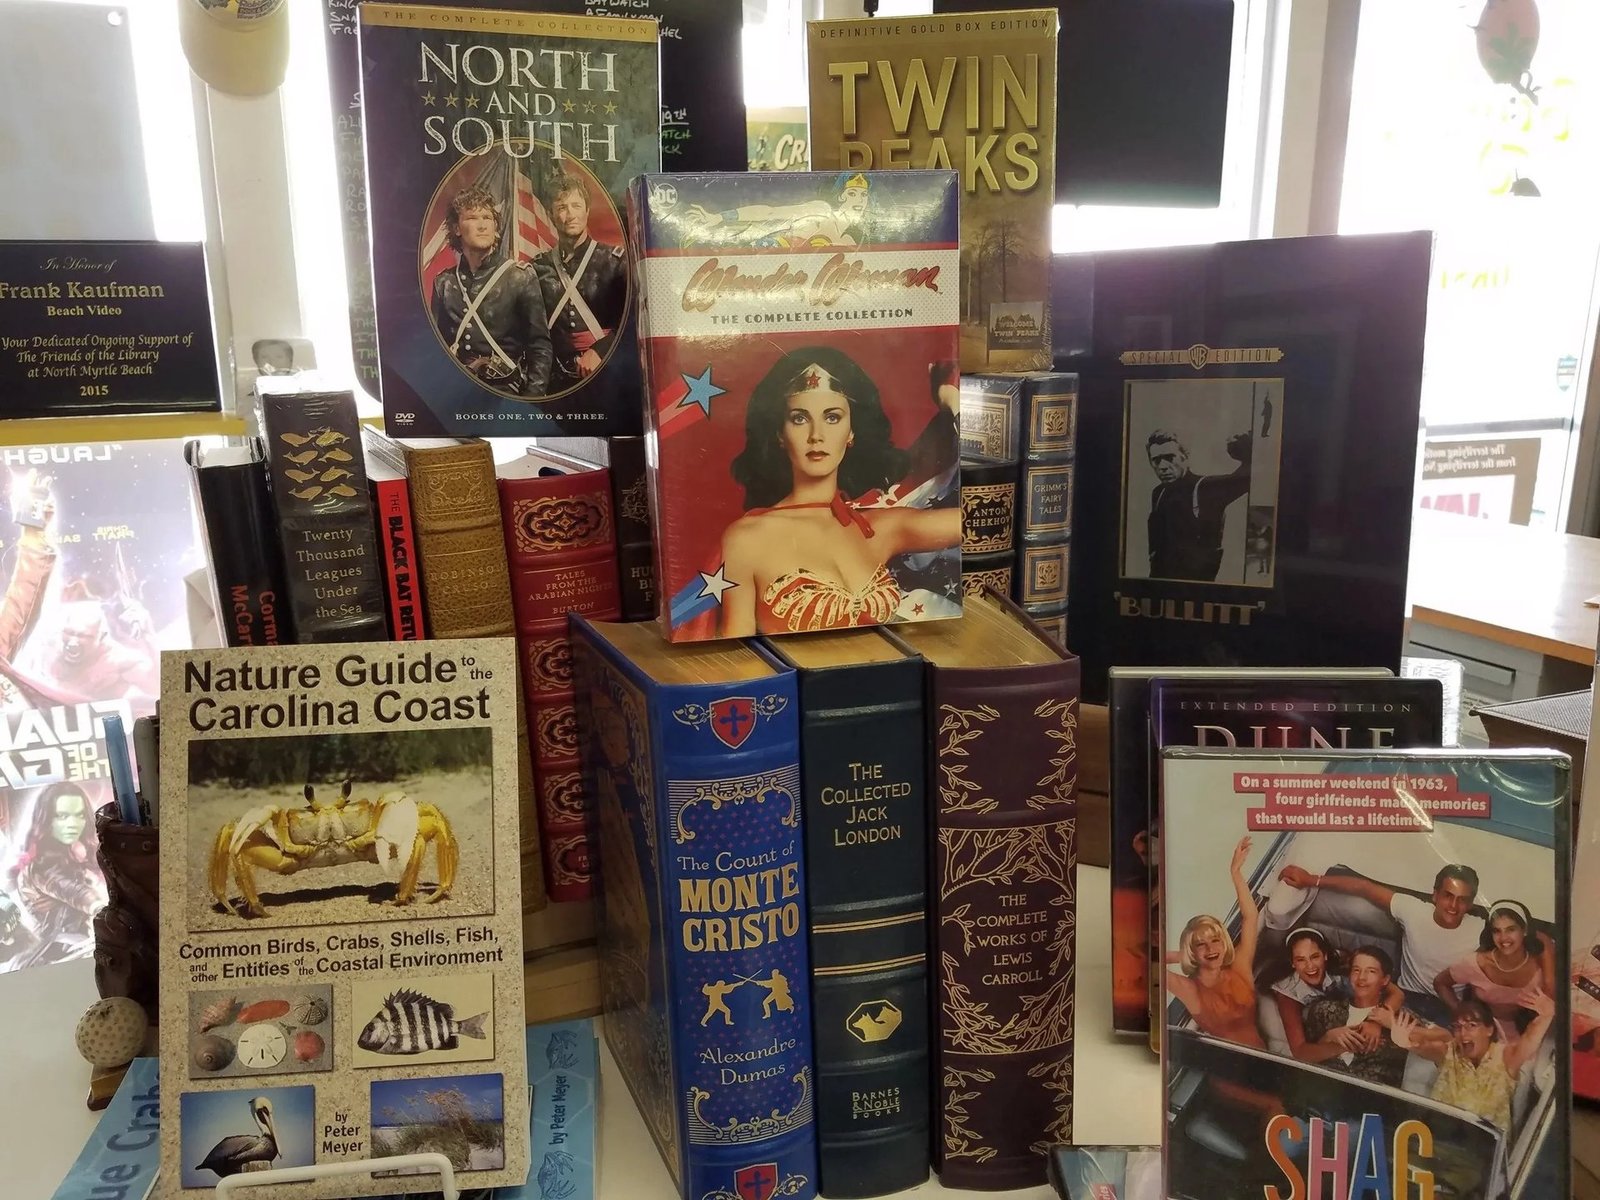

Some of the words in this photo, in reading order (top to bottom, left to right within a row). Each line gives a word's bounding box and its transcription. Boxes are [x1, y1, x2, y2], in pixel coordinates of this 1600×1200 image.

[383, 10, 417, 22] THE
[430, 13, 526, 27] COMPLETE
[538, 20, 648, 35] COLLECTION
[820, 25, 902, 39] DEFINITIVE
[911, 23, 945, 34] GOLD
[955, 21, 981, 32] BOX
[991, 18, 1049, 30] EDITION
[418, 41, 619, 93] NORTH
[828, 53, 1039, 135] TWIN
[485, 92, 556, 116] AND
[424, 116, 621, 163] SOUTH
[774, 134, 807, 170] CR
[839, 132, 1039, 192] PEAKS
[40, 258, 58, 270] In
[63, 257, 101, 271] Honor
[104, 259, 117, 273] of
[0, 282, 61, 299] Frank
[67, 281, 164, 298] Kaufman
[681, 257, 809, 312] Wonder
[808, 252, 941, 307] Woman
[47, 305, 84, 316] Beach
[88, 305, 122, 316] Video
[711, 314, 739, 325] THE
[744, 312, 821, 324] COMPLETE
[826, 308, 914, 321] COLLECTION
[1, 336, 29, 350] Your
[32, 334, 88, 347] Dedicated
[91, 335, 135, 350] Ongoing
[138, 333, 179, 348] Support
[182, 332, 194, 347] of
[17, 351, 36, 364] The
[40, 350, 82, 364] Friends
[85, 349, 96, 364] of
[99, 349, 115, 361] the
[118, 349, 160, 362] Library
[1131, 351, 1181, 364] SPECIAL
[1215, 349, 1271, 362] EDITION
[27, 367, 39, 378] at
[43, 365, 76, 377] North
[80, 364, 118, 380] Myrtle
[121, 363, 153, 376] Beach
[80, 385, 109, 396] 2015
[499, 413, 525, 421] ONE,
[390, 491, 400, 513] THE
[1041, 494, 1063, 504] FAIRY
[973, 506, 1007, 517] ANTON
[1039, 505, 1062, 515] TALES
[965, 516, 1010, 527] CHEKHOV
[302, 528, 354, 543] Twenty
[388, 515, 410, 569] BLACK
[296, 545, 365, 562] Thousand
[305, 566, 363, 583] Leagues
[430, 565, 501, 580] ROBINSO
[555, 570, 586, 581] TALES
[395, 573, 413, 602] BAT
[545, 581, 575, 590] FROM
[577, 577, 596, 586] THE
[314, 585, 359, 600] Under
[528, 589, 575, 601] ARABIAN
[231, 585, 254, 646] McCar
[316, 607, 337, 619] the
[341, 604, 362, 619] Sea
[553, 602, 594, 614] BURTON
[184, 658, 321, 693] Nature
[335, 651, 458, 687] Guide
[461, 656, 476, 667] to
[470, 668, 493, 680] the
[188, 694, 359, 732] Carolina
[373, 686, 491, 723] Coast
[1180, 702, 1295, 712] EXTENDED
[1313, 703, 1412, 713] EDITION
[849, 762, 883, 781] THE
[1240, 776, 1260, 788] On
[1262, 779, 1270, 788] a
[1273, 779, 1329, 789] summer
[1330, 776, 1390, 789] weekend
[1393, 776, 1406, 789] in
[1410, 778, 1448, 791] 1963,
[820, 782, 911, 805] COLLECTED
[1275, 793, 1303, 805] four
[1306, 792, 1376, 809] girlfriends
[1420, 797, 1486, 810] memories
[846, 806, 888, 824] JACK
[1255, 812, 1283, 825] that
[1286, 812, 1327, 825] would
[1329, 812, 1354, 825] last
[1357, 815, 1365, 825] a
[834, 825, 901, 846] LONDON
[676, 856, 710, 871] The
[715, 847, 778, 872] Count
[782, 840, 795, 856] of
[678, 862, 800, 913] MONTE
[998, 894, 1027, 907] THE
[682, 902, 800, 953] CRISTO
[976, 911, 1047, 928] COMPLETE
[179, 942, 262, 960] Common
[267, 937, 320, 956] Birds,
[326, 934, 385, 953] Crabs,
[390, 929, 450, 949] Shells,
[456, 926, 499, 944] Fish,
[976, 933, 1026, 948] WORKS
[1031, 930, 1048, 943] OF
[294, 957, 305, 967] of
[316, 954, 384, 974] Coastal
[389, 947, 504, 969] Environment
[993, 952, 1032, 966] LEWIS
[190, 963, 208, 972] and
[222, 961, 290, 979] Entities
[298, 965, 314, 976] the
[191, 972, 218, 983] other
[982, 970, 1043, 985] CARROLL
[700, 1037, 797, 1065] Alexandre
[721, 1063, 786, 1086] Dumas
[553, 1074, 568, 1104] Meyer
[852, 1087, 900, 1101] BARNES
[853, 1102, 863, 1111] &
[864, 1097, 900, 1110] NOBLE
[335, 1111, 348, 1124] by
[550, 1104, 568, 1128] Peter
[853, 1107, 900, 1120] BOOKS
[324, 1125, 361, 1138] Peter
[549, 1129, 568, 1144] by
[322, 1139, 363, 1155] Meyer
[1263, 1113, 1436, 1200] SHAG
